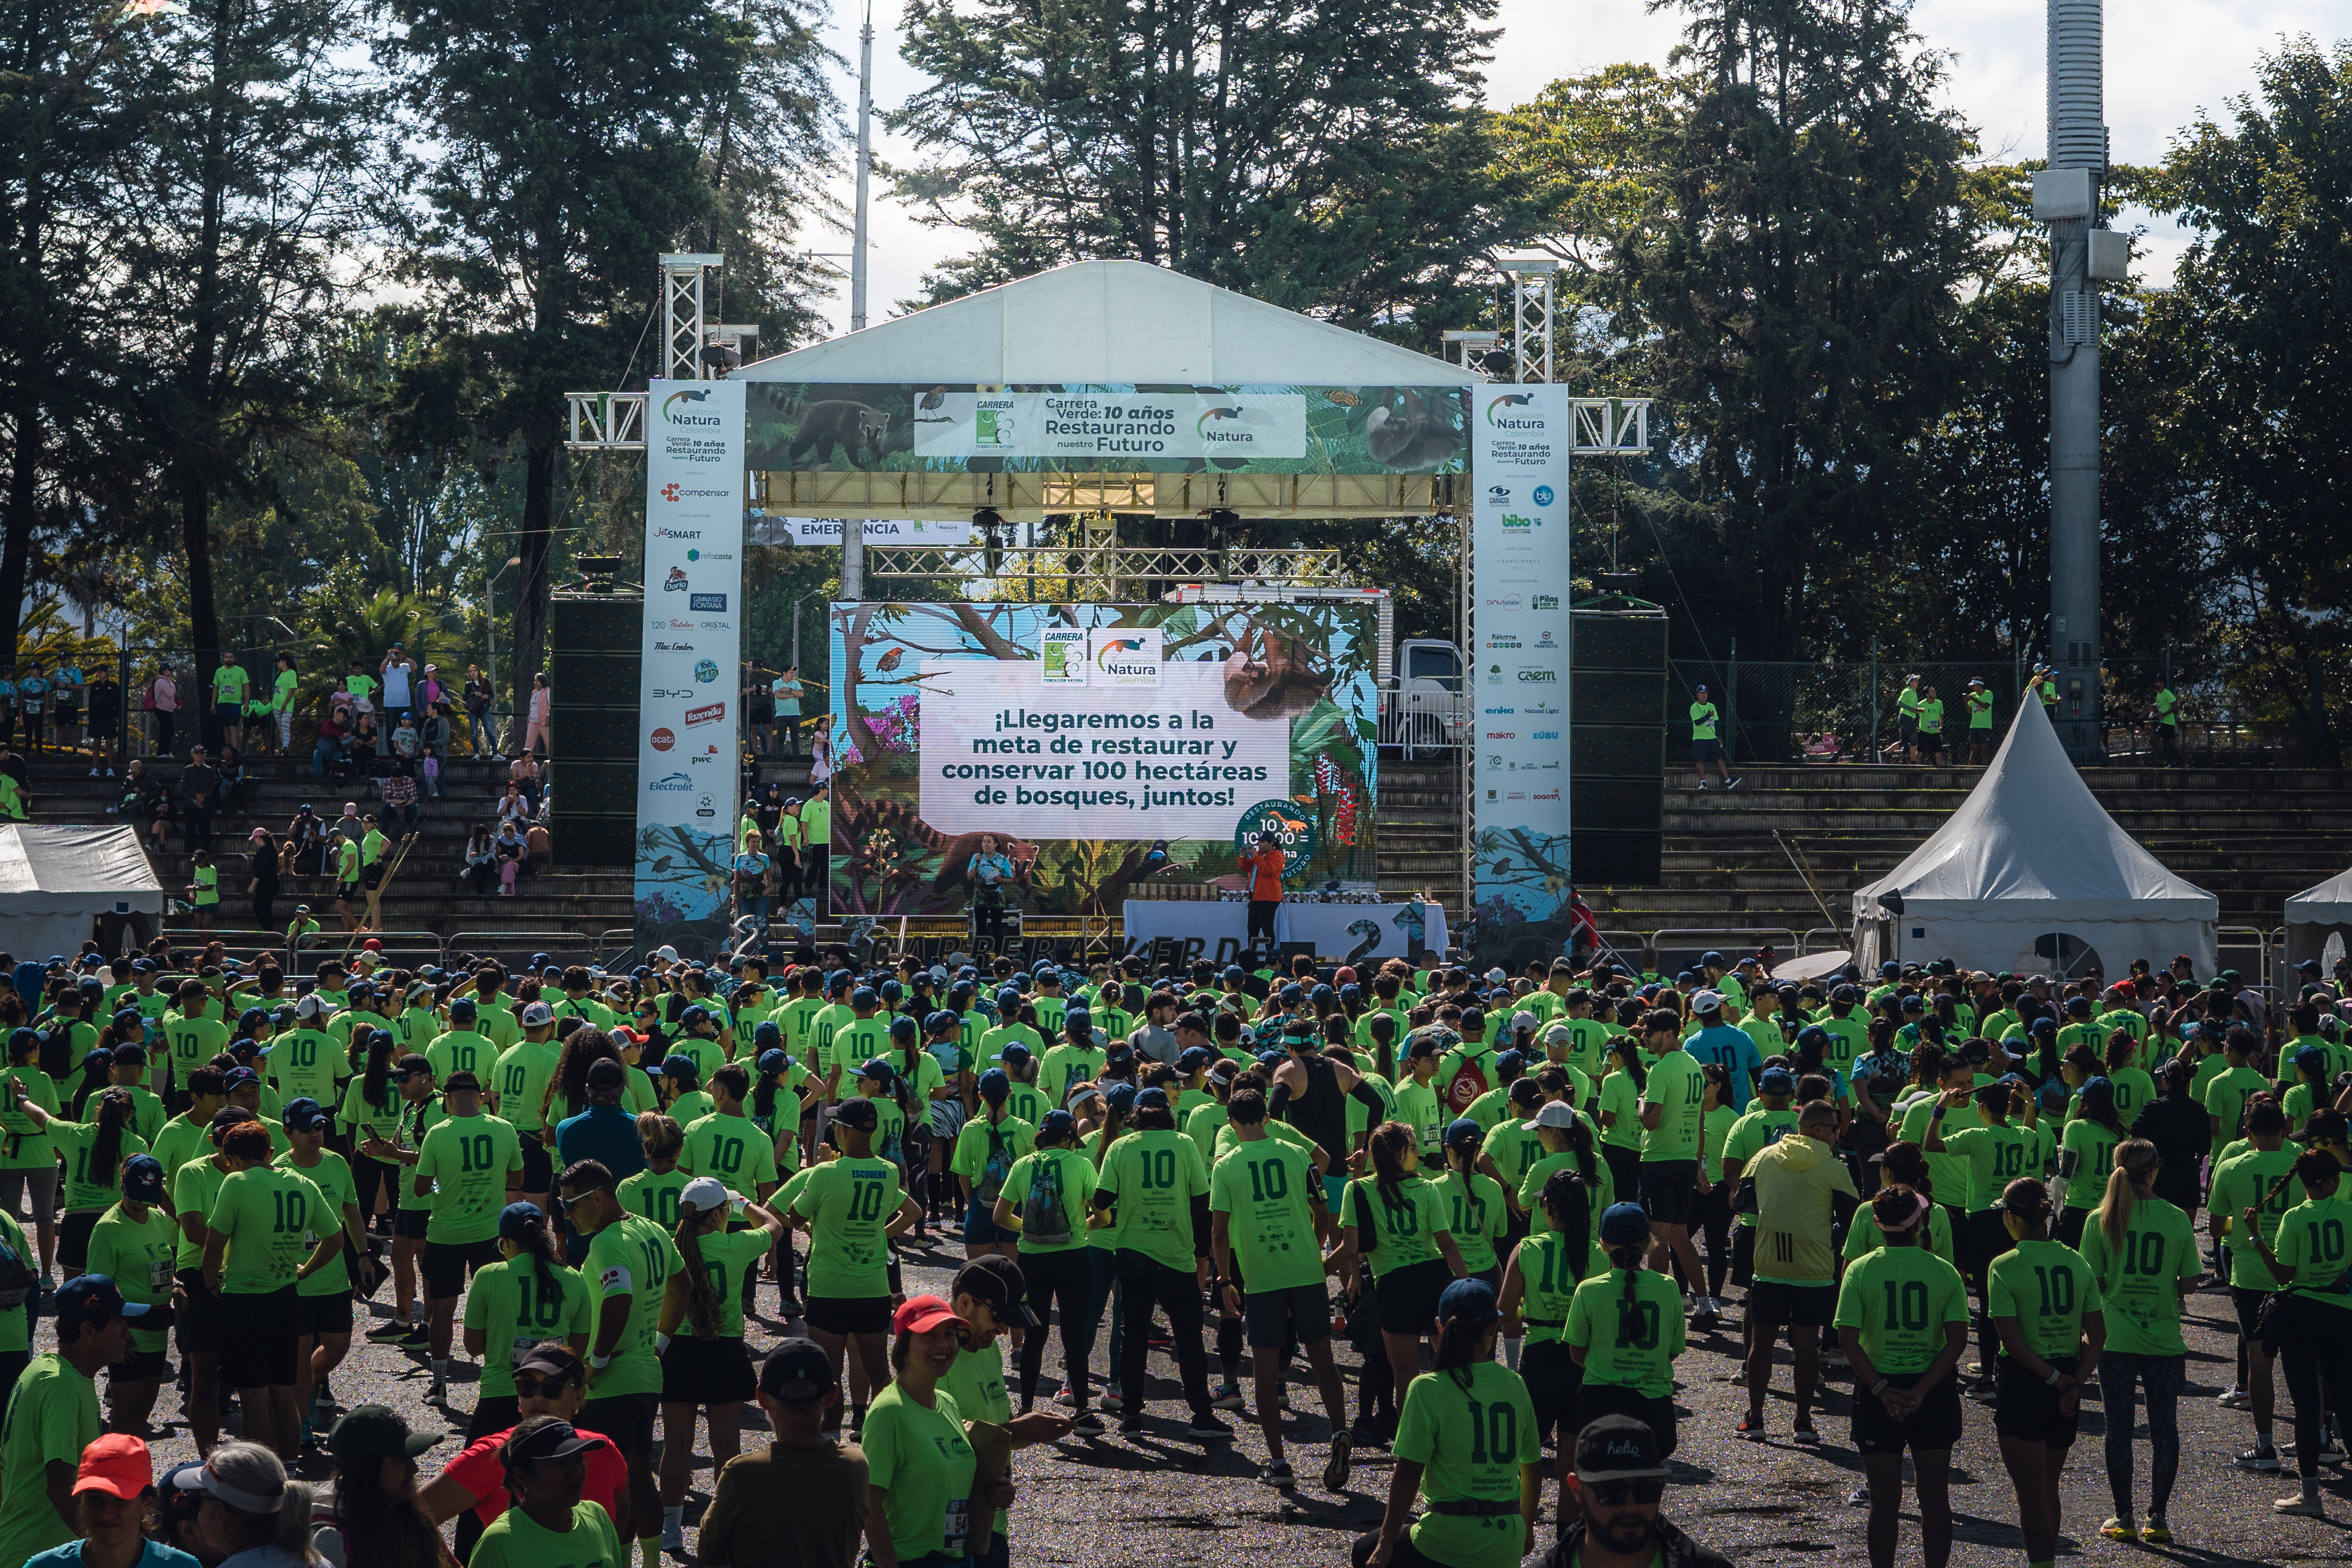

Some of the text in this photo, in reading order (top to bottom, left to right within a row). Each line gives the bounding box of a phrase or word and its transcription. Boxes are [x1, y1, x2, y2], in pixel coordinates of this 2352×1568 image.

[1046, 397, 1097, 409] Carrera
[1056, 405, 1174, 419] Verde: 10 años
[673, 415, 720, 425] Natura
[1497, 419, 1544, 429] Natura
[1046, 420, 1175, 436] Restaurando
[1206, 431, 1253, 442] Natura
[666, 446, 725, 455] Restaurando
[1097, 437, 1164, 452] Futuro
[1214, 442, 1253, 451] Colombia
[679, 489, 729, 498] compensar
[1536, 491, 1551, 501] blu
[1502, 513, 1531, 527] bibo
[802, 524, 899, 535] EMERNCIA
[665, 581, 687, 590] Doria
[1045, 633, 1083, 641] CARRERA
[700, 662, 712, 670] Top
[1108, 664, 1156, 675] Natura
[694, 668, 719, 683] Terra
[1518, 670, 1557, 681] caem
[653, 689, 693, 698] BYD
[687, 706, 721, 722] fazenda
[996, 709, 1214, 734] ¡Llegaremos a la
[651, 736, 674, 744] ocati
[1487, 731, 1515, 739] makro
[973, 736, 1238, 760] meta de restaurar y
[942, 761, 1267, 781] conservar 100 hectáreas
[650, 782, 694, 791] Electrolit
[974, 785, 1235, 810] de bosques, juntos!
[1245, 801, 1306, 820] RESTAURANDO
[1260, 819, 1291, 832] 10 x
[1281, 855, 1310, 879] FUTURO
[290, 1039, 317, 1067] 10
[1686, 1072, 1702, 1104] 10
[460, 1134, 494, 1172] 10
[852, 1169, 887, 1180] ESCUDERO
[1141, 1149, 1175, 1189] 10
[1247, 1157, 1288, 1202] 10
[846, 1181, 884, 1221] 10
[273, 1190, 306, 1233] 10
[1255, 1206, 1290, 1215] Restaurando
[2308, 1218, 2344, 1264] 10
[2124, 1230, 2165, 1276] 10
[2034, 1264, 2074, 1316] 10
[1884, 1280, 1928, 1331] 10
[1615, 1298, 1660, 1350] 10
[1613, 1358, 1656, 1367] Restaurando
[1468, 1401, 1517, 1464] 10
